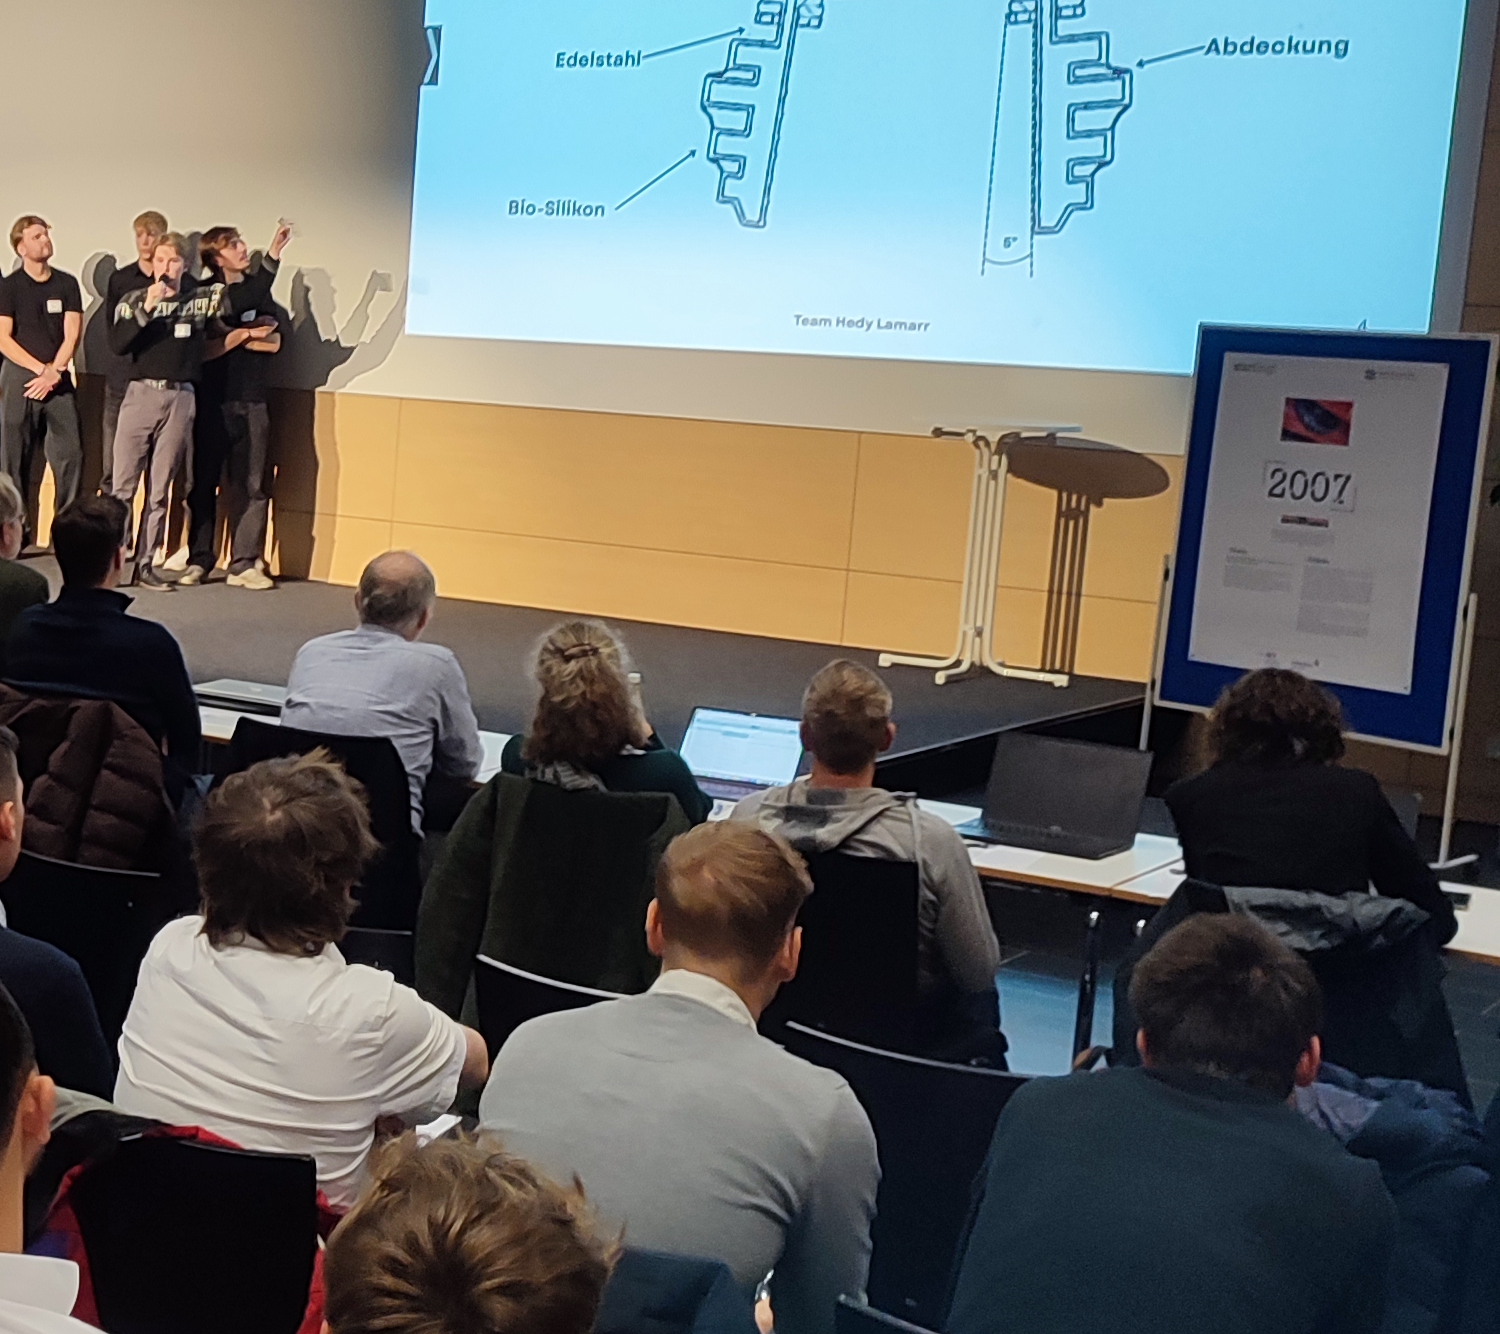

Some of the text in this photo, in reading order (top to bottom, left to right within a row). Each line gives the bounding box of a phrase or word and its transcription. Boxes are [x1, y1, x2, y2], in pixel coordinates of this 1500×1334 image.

[1204, 35, 1350, 60] Abdeckung
[555, 49, 641, 68] Edelstahl
[508, 198, 605, 217] Bio-Silikon
[794, 314, 930, 332] Team Hedy Lamarr
[1267, 467, 1352, 505] 2007
